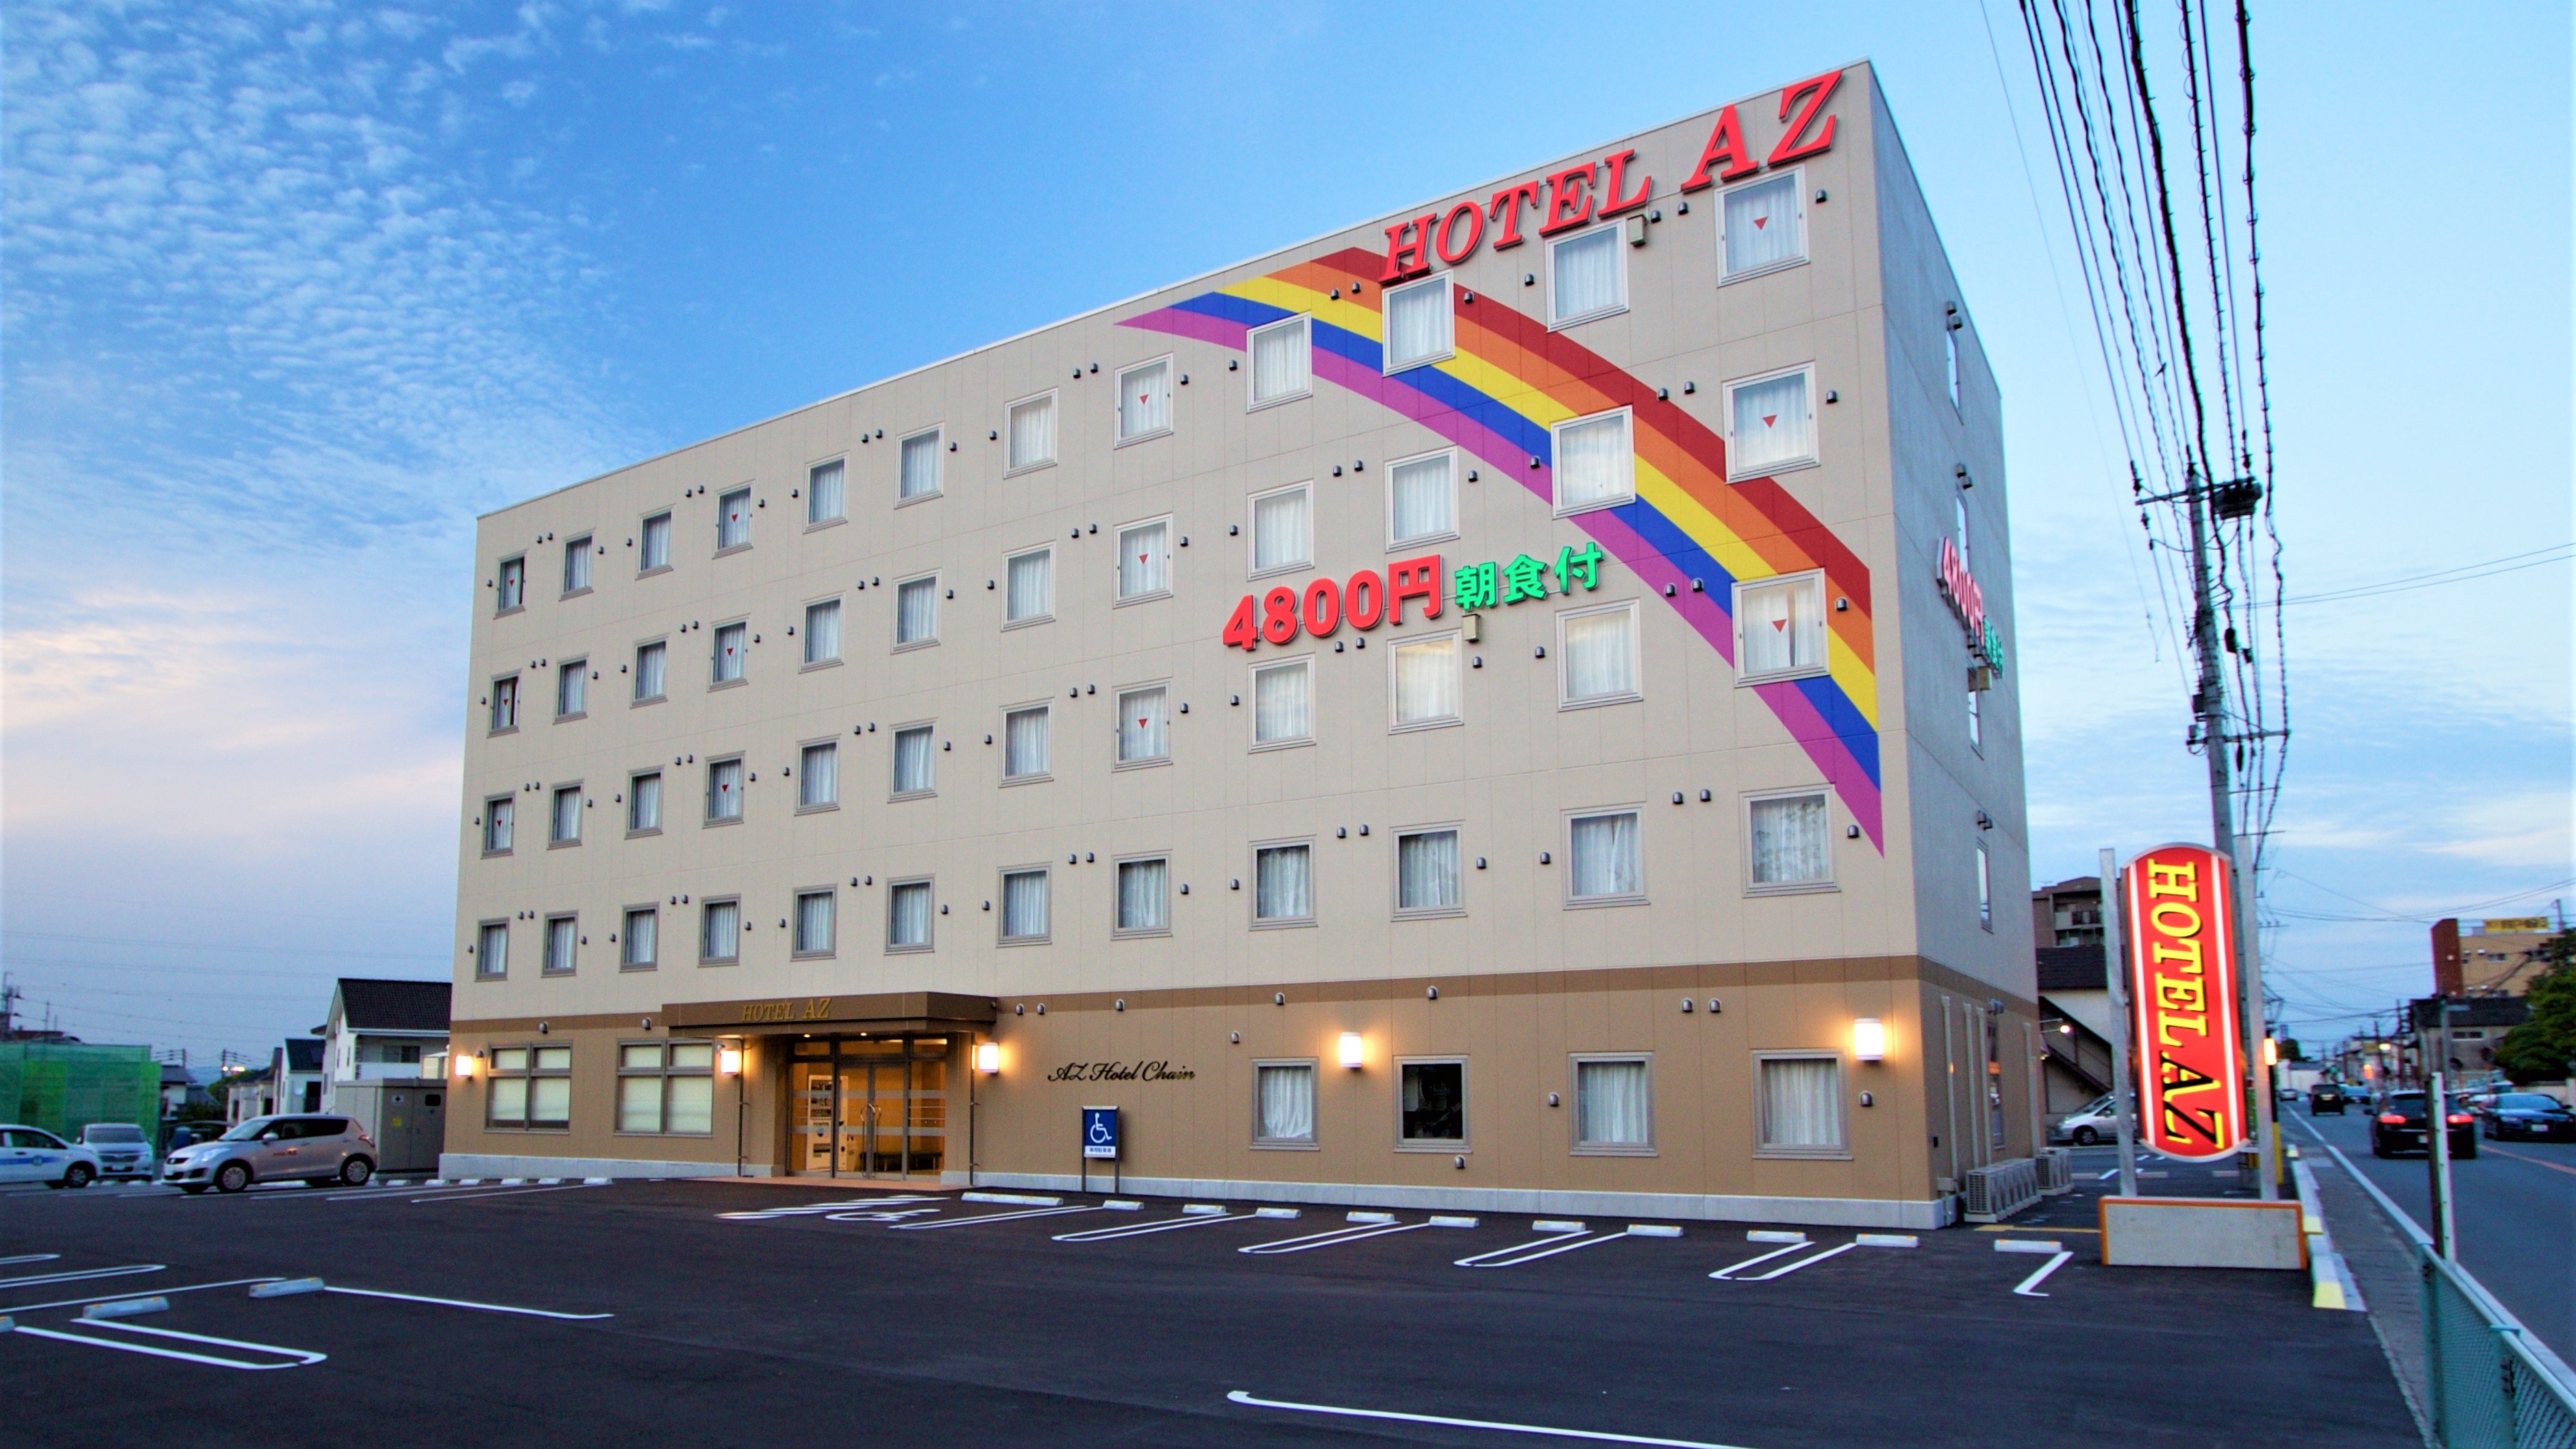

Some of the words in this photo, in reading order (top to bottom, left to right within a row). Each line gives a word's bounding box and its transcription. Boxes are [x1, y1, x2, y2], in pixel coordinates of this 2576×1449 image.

[1378, 149, 1652, 286] HOTEL
[1681, 69, 1842, 192] AZ
[1223, 554, 1441, 651] 4800円
[1454, 541, 1603, 611] 朝食付
[2147, 858, 2208, 1048] HOTEL
[742, 1002, 795, 1021] HOTEL
[801, 998, 831, 1019] AZ
[1047, 1062, 1088, 1082] AZ
[1089, 1061, 1144, 1082] Hotel
[1141, 1061, 1196, 1082] Chain
[2160, 1050, 2225, 1150] AZ
